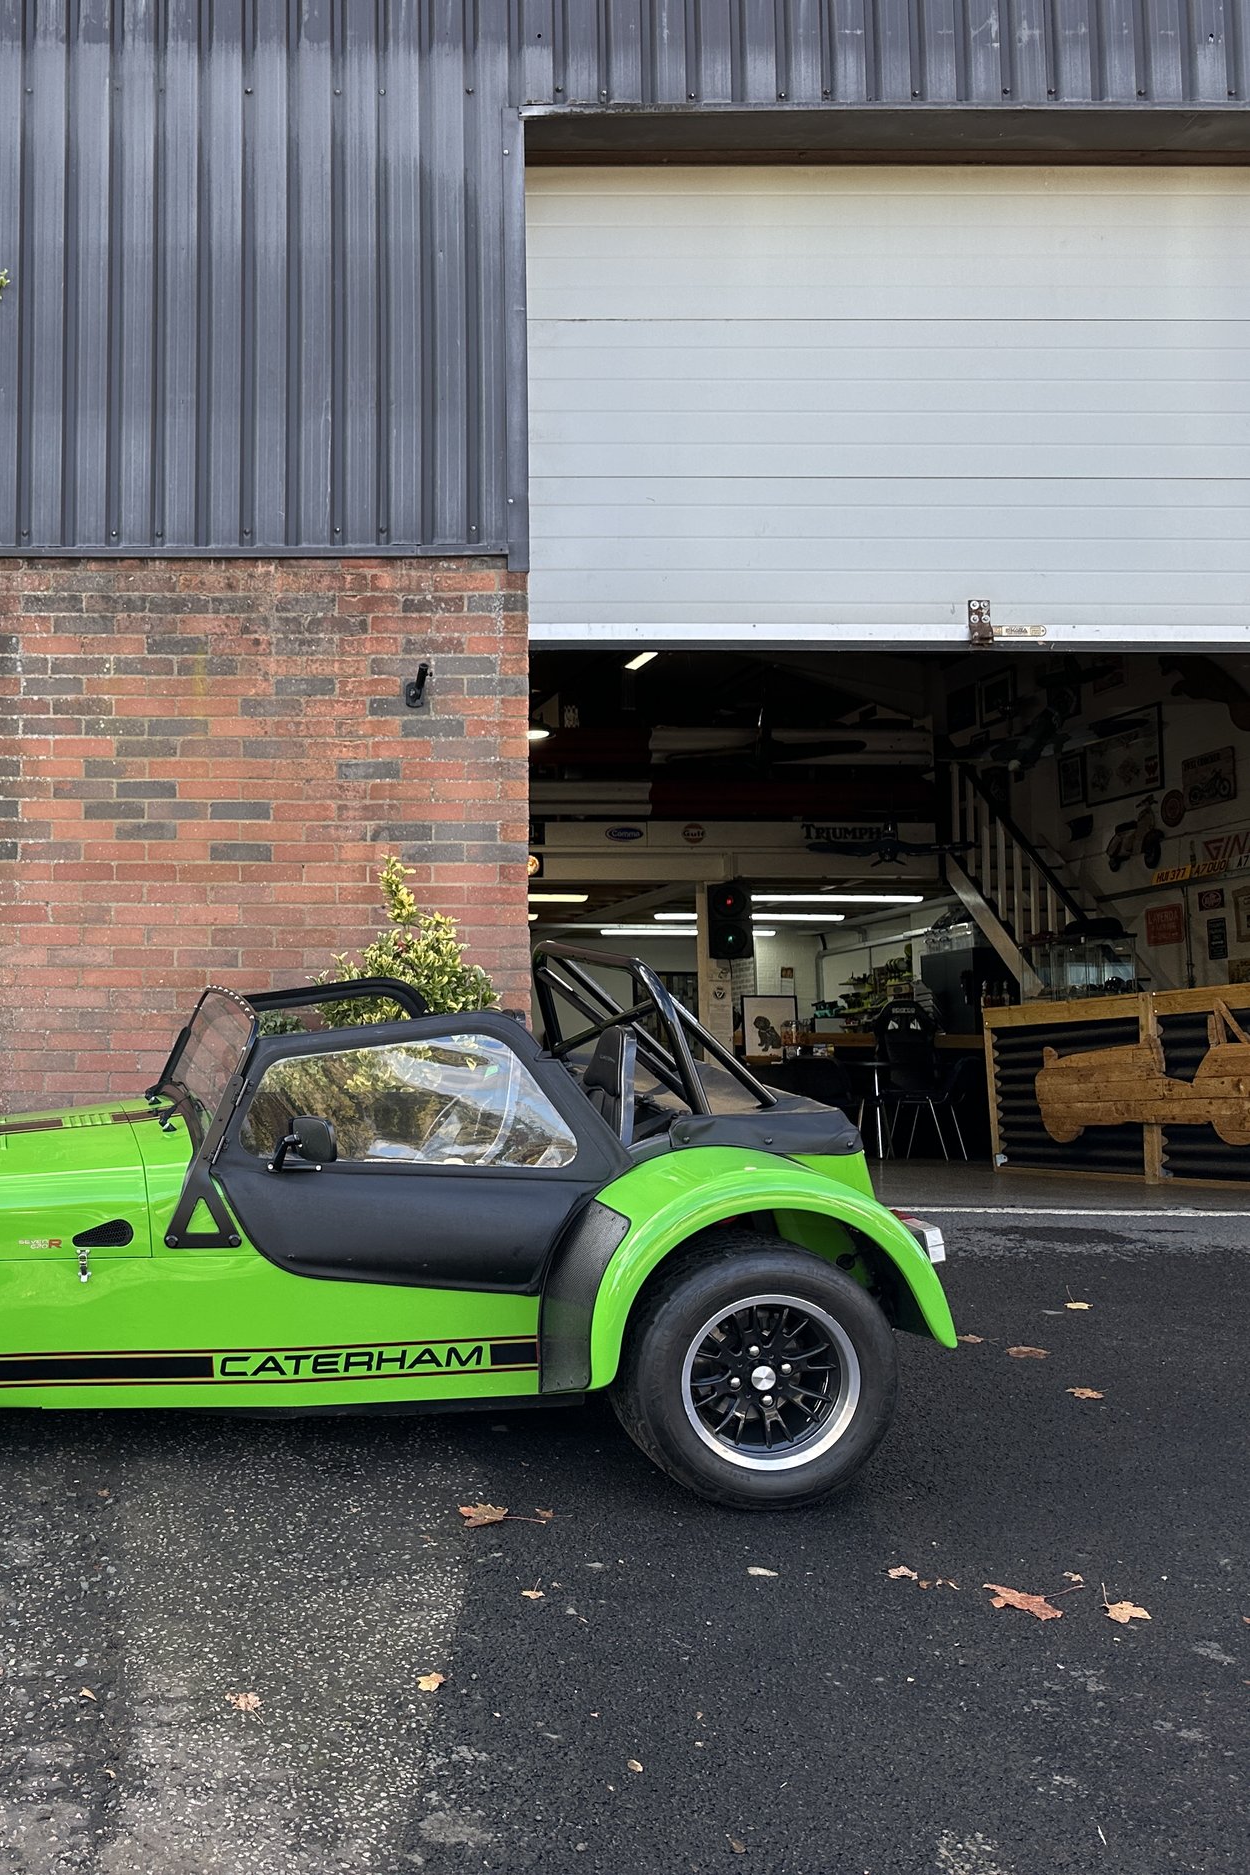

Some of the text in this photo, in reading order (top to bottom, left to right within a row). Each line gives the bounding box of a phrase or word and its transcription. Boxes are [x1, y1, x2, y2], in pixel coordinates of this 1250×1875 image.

[611, 829, 642, 839] Comma
[683, 829, 704, 837] Gulf
[801, 823, 882, 841] TRIUMPH
[219, 1345, 484, 1377] CATERHAM
